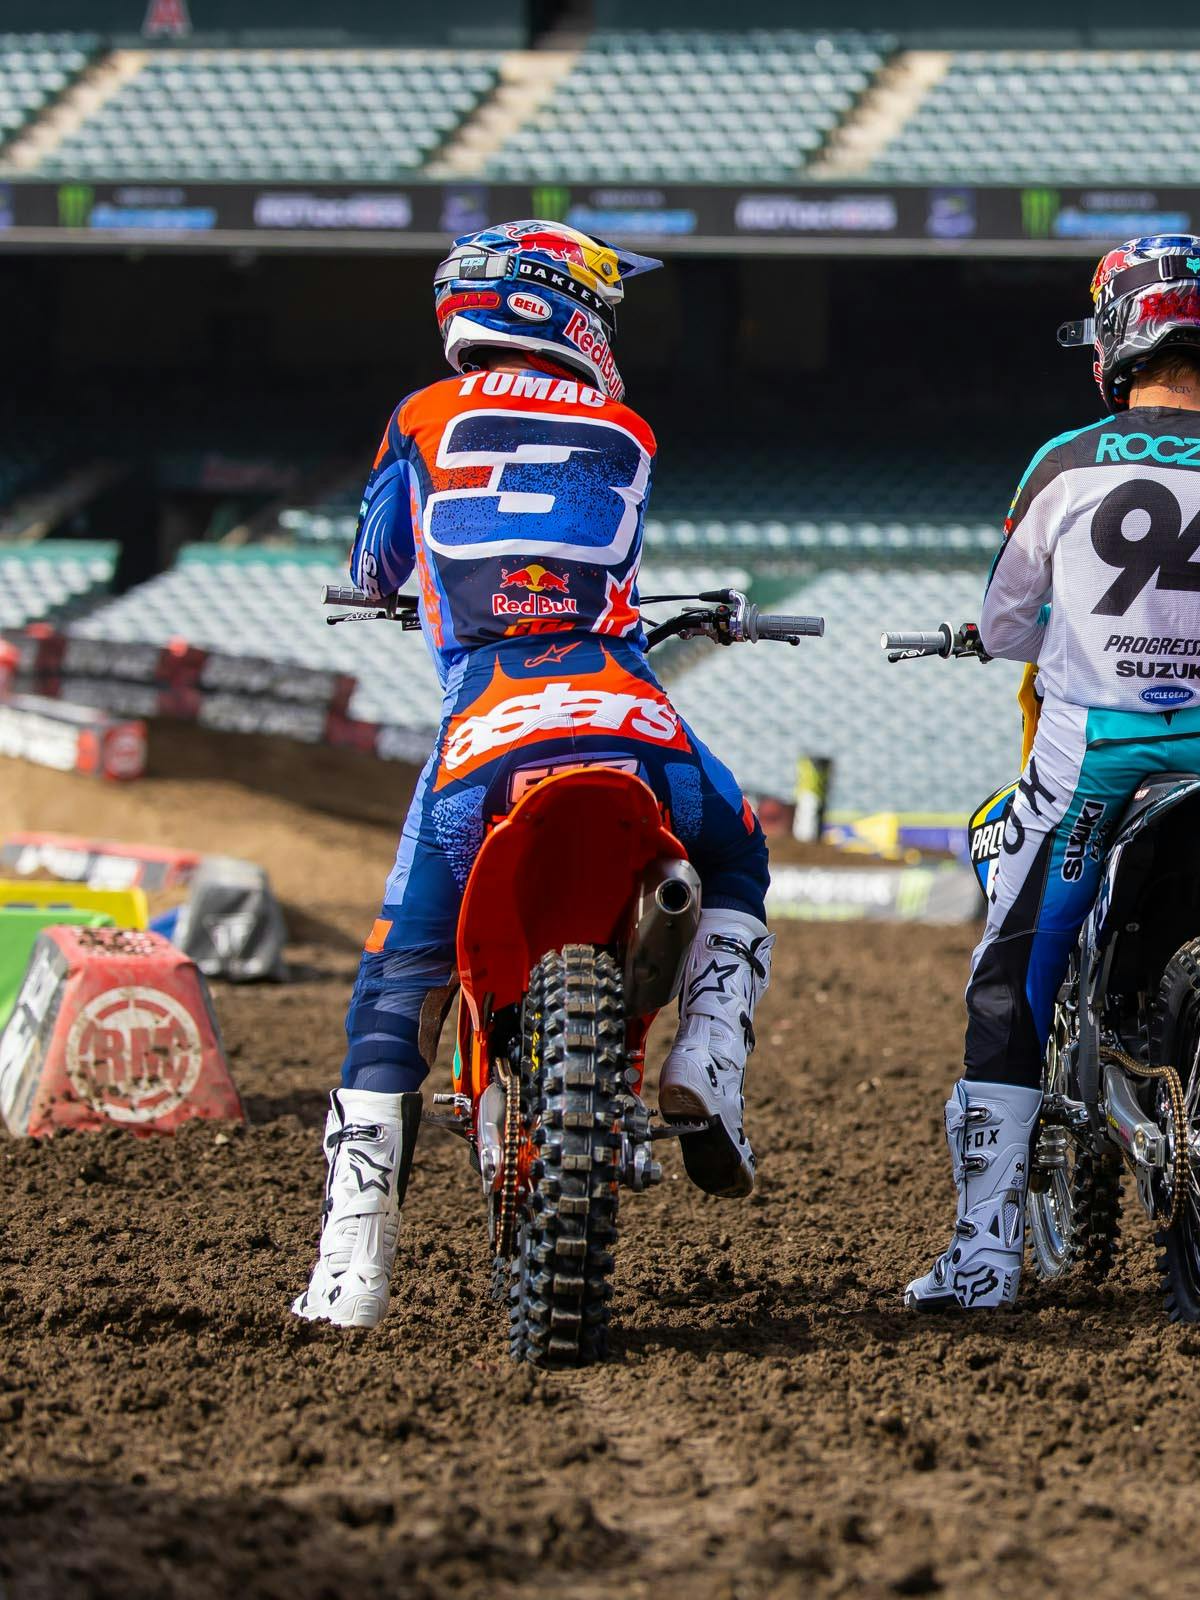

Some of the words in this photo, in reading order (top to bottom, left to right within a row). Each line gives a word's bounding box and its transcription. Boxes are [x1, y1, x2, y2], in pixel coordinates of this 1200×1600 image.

[519, 264, 604, 310] OAKLEY
[514, 296, 546, 318] BELL
[562, 308, 607, 367] Red
[458, 371, 608, 408] TOMAC
[423, 408, 652, 566] 3
[492, 593, 536, 616] Red
[538, 594, 580, 616] Bull
[900, 649, 926, 658] ASV
[1144, 691, 1168, 700] CYCLE
[1168, 690, 1190, 699] GEAR
[444, 682, 680, 770] astars
[966, 1128, 1000, 1151] FOX
[1002, 1272, 1013, 1298] FOX
